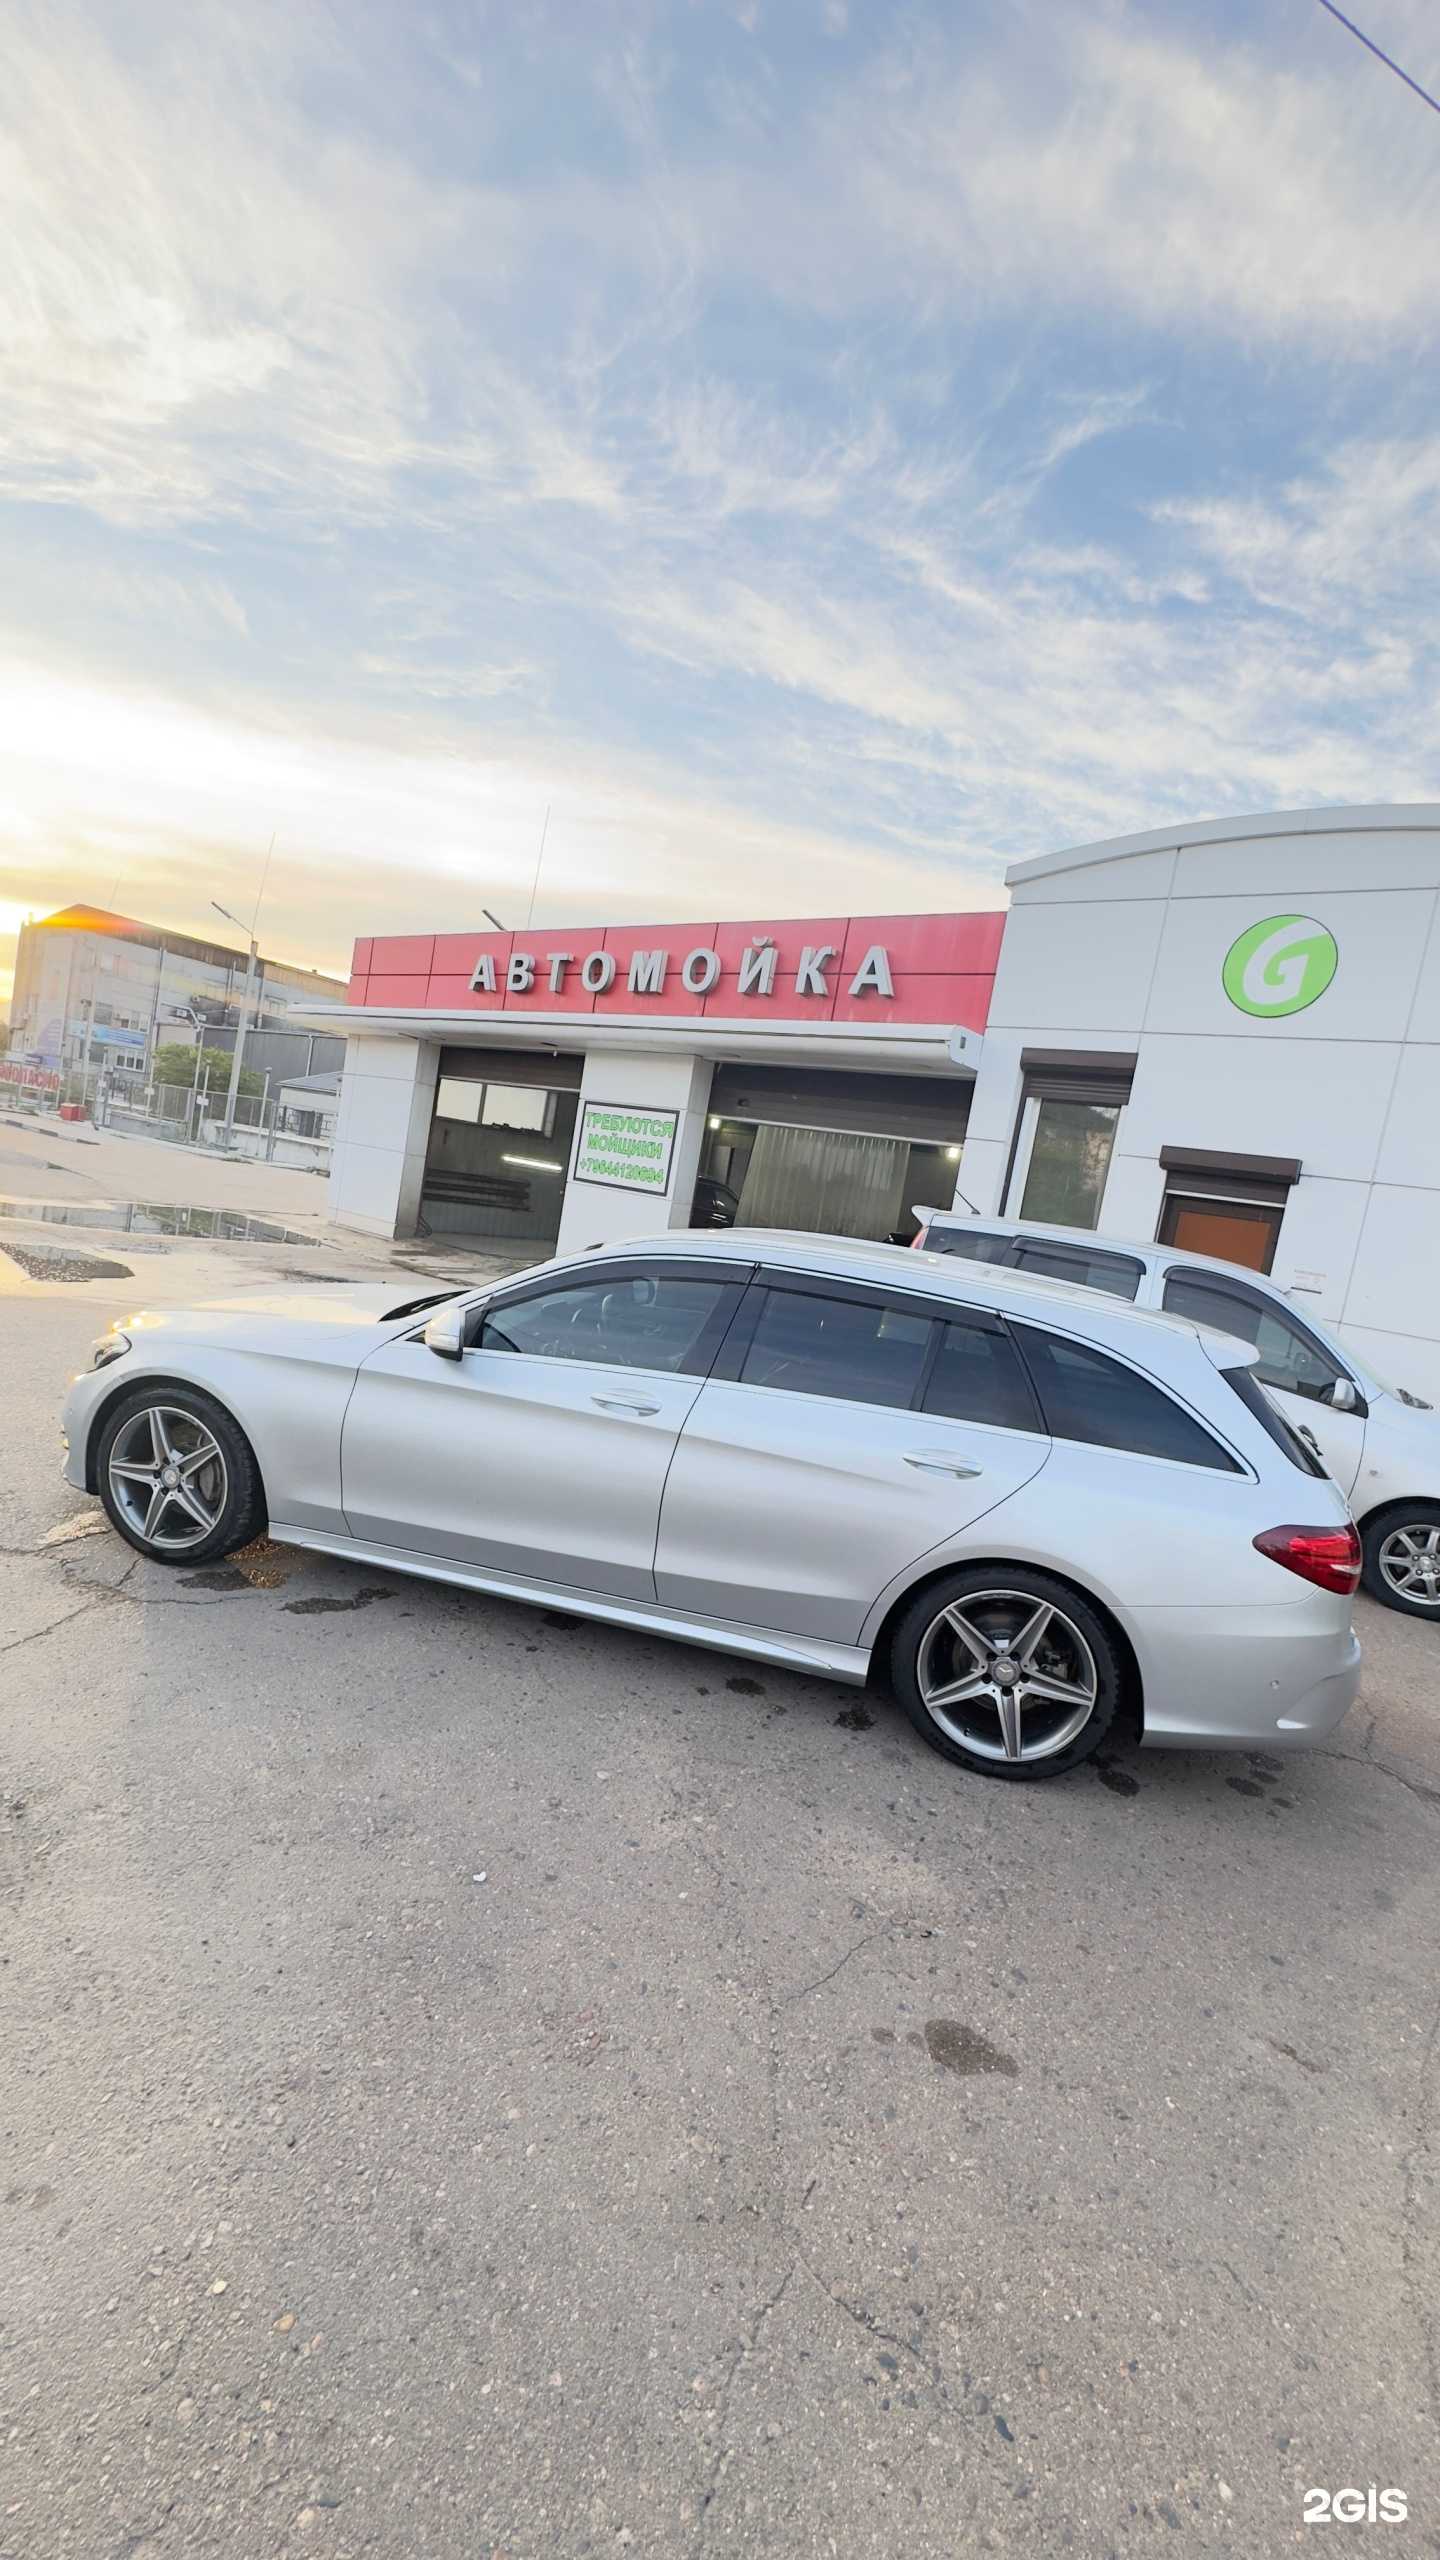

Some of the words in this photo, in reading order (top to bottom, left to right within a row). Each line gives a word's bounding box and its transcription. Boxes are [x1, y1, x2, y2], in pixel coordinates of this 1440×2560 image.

[467, 936, 895, 998] АВТОМОЙКА
[585, 1111, 674, 1139] ТРЕБУЮТСЯ
[587, 1132, 664, 1160] МОЙЩИКИ
